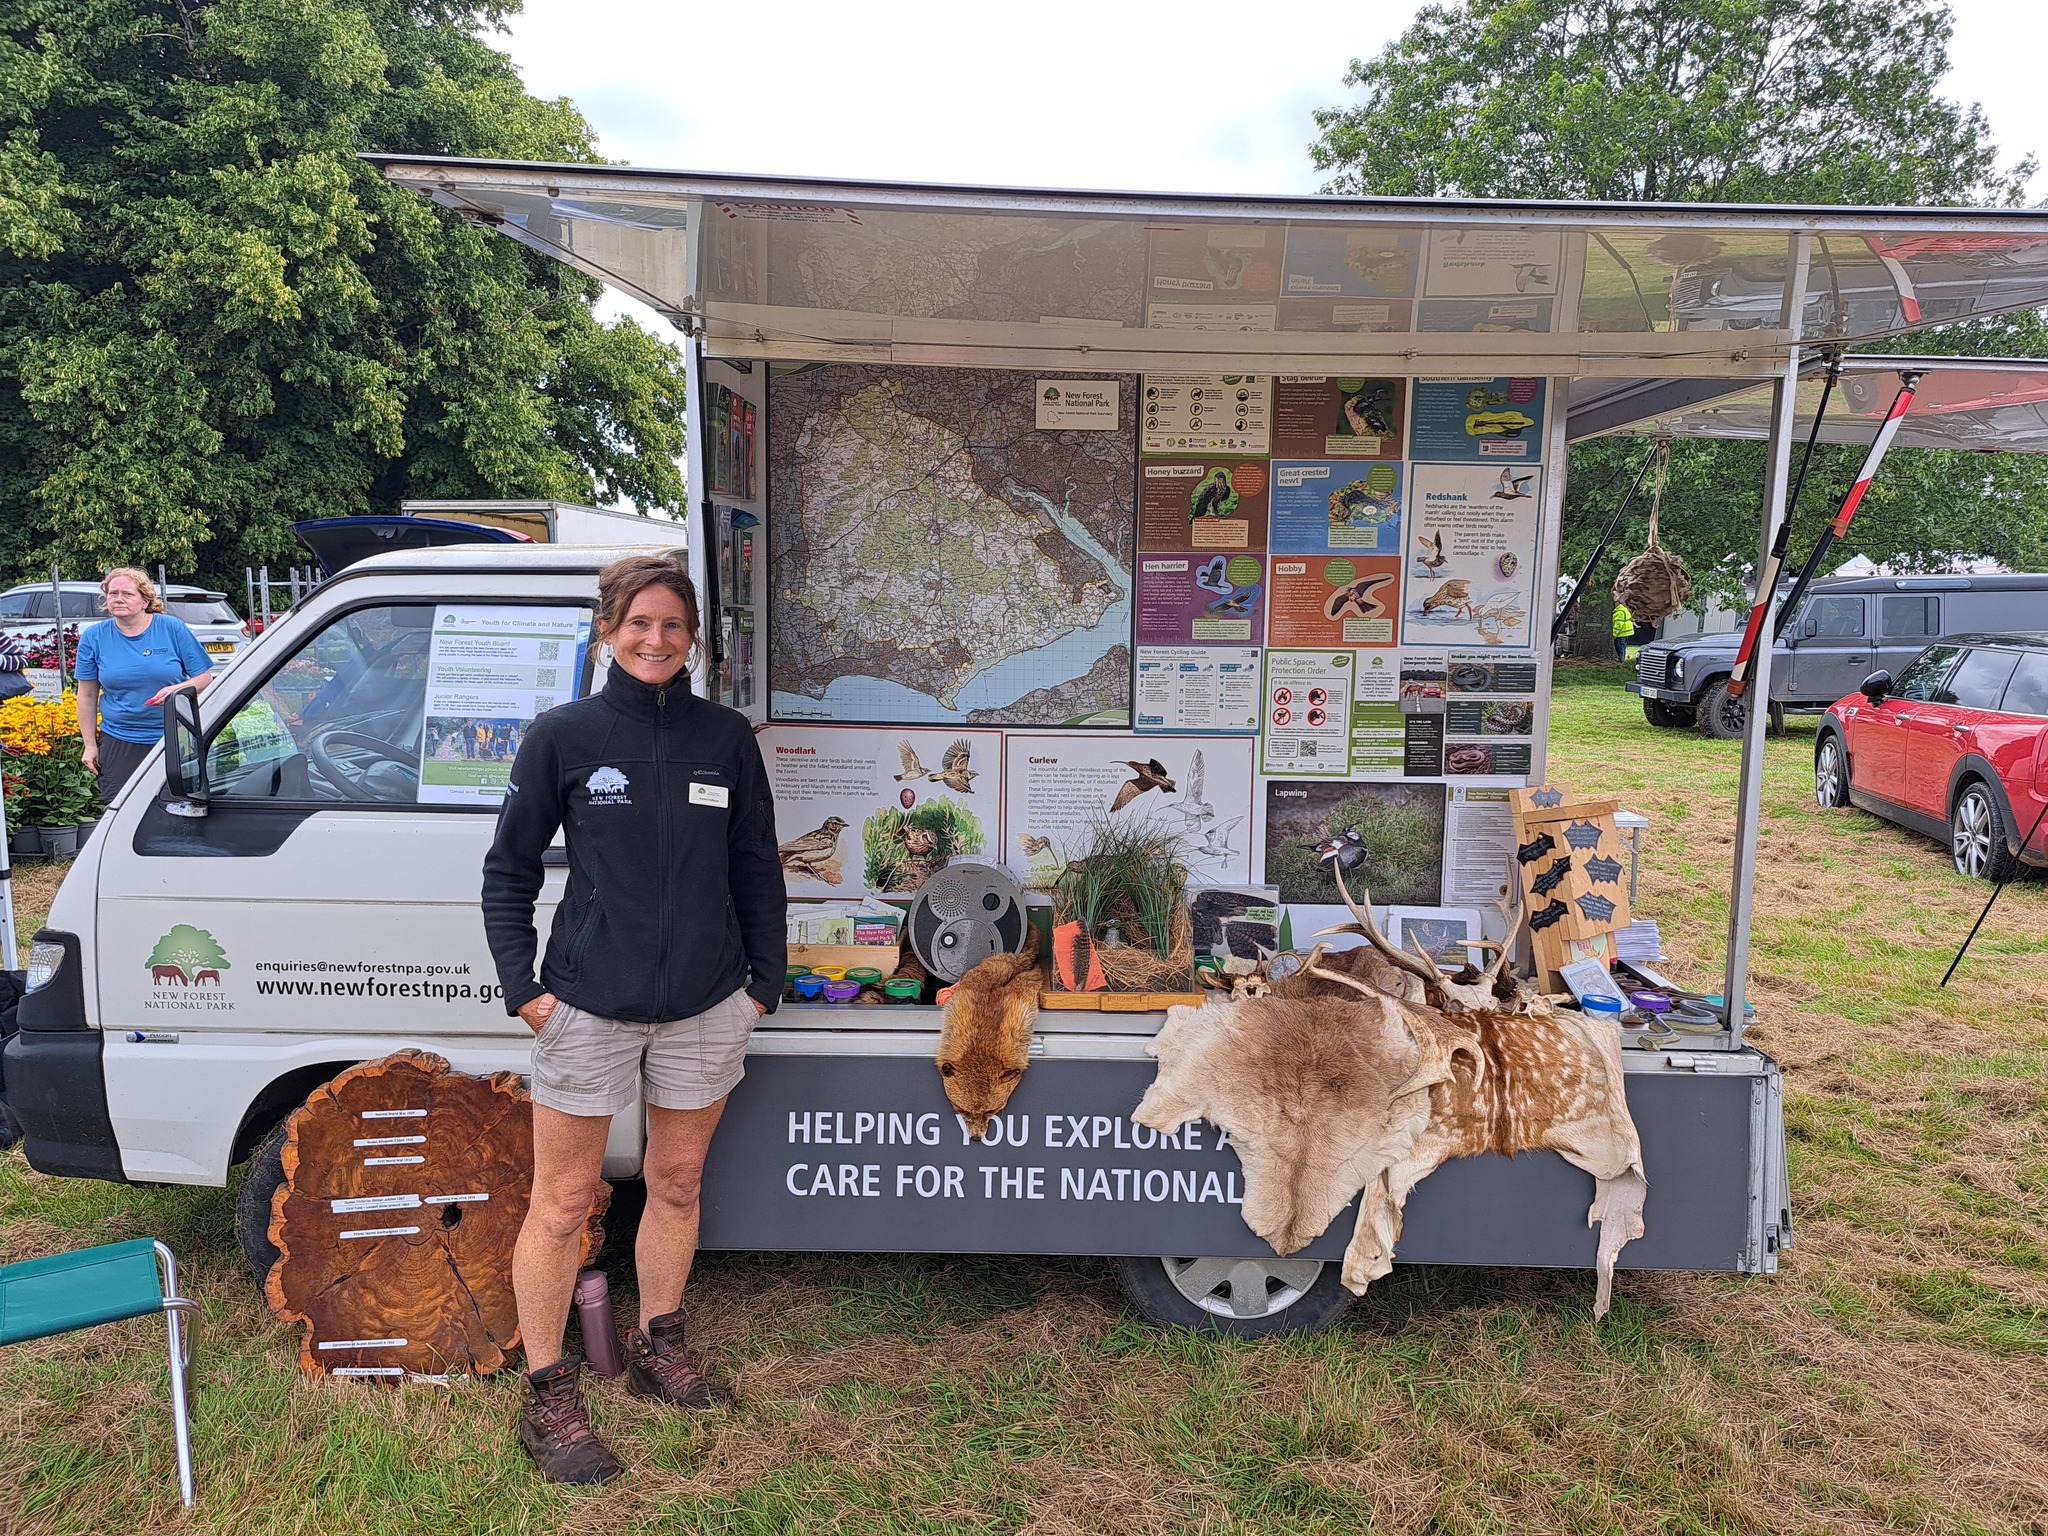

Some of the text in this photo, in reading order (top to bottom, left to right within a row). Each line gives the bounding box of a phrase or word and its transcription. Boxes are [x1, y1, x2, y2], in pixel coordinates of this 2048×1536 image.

[1082, 392, 1103, 400] Forest
[1095, 400, 1110, 408] Park
[1148, 467, 1202, 476] Honey buzzard
[1426, 493, 1468, 501] Redshank
[1145, 561, 1185, 571] Hen harrier
[1278, 565, 1303, 573] Hobby
[1271, 658, 1316, 667] Public Spaces
[456, 666, 492, 674] Volunteering
[1271, 667, 1327, 675] Protection Order
[776, 747, 816, 755] Woodlark
[1275, 789, 1307, 798] Lapwing
[256, 961, 470, 976] enquiries@newforestnpa.gov.uk
[256, 977, 505, 1003] www.newforestnpa.go
[153, 992, 226, 1001] NEW FOREST
[144, 1002, 236, 1011] NATIONAL PARK
[788, 1111, 940, 1145] HELPING
[956, 1114, 1029, 1147] YOU
[786, 1163, 1244, 1204] CARE FOR THE NATIONAL
